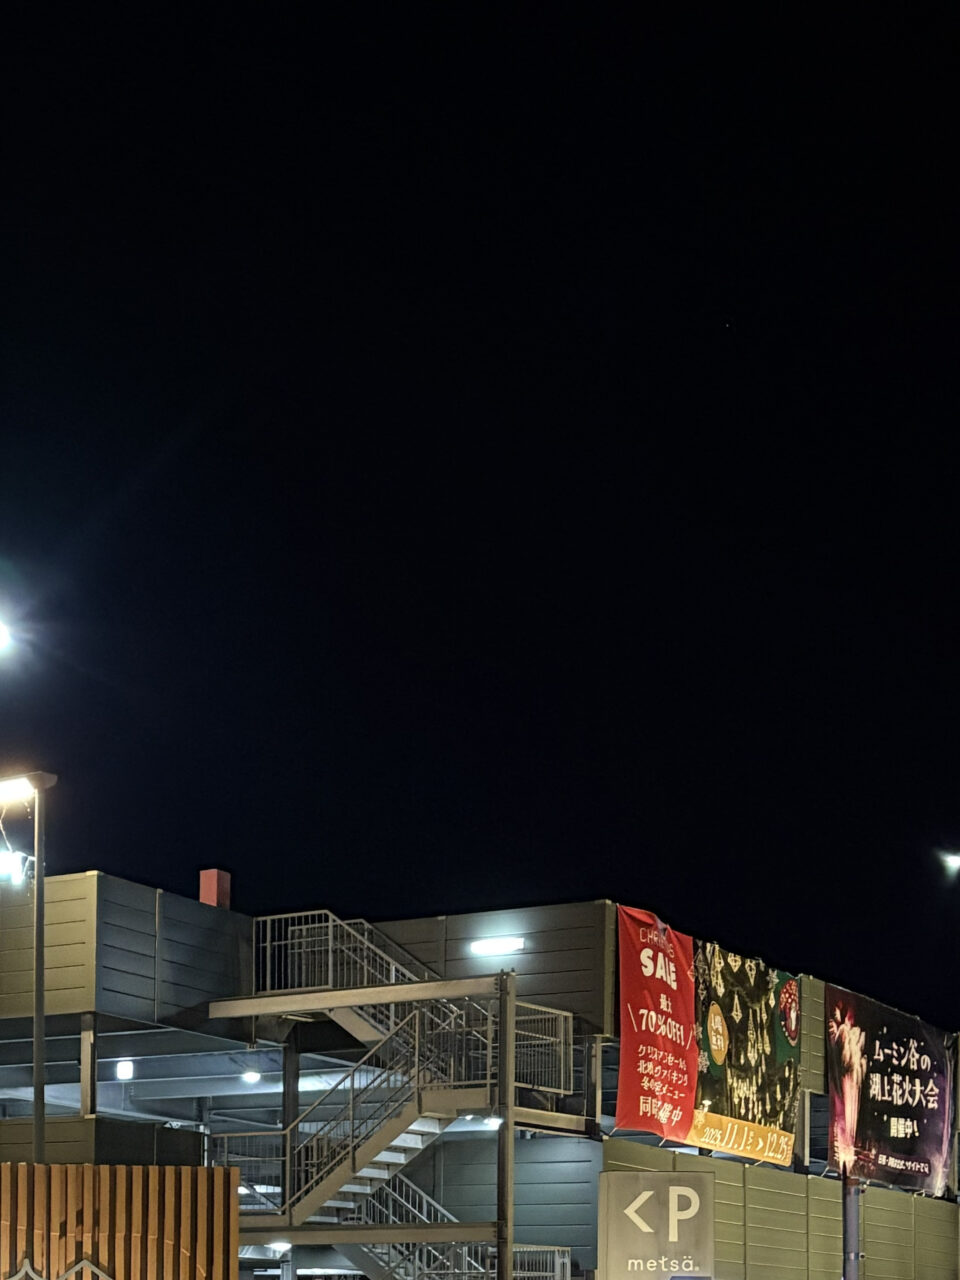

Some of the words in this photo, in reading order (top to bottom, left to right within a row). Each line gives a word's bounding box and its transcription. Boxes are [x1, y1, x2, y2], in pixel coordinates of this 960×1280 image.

[640, 948, 677, 990] SALE
[874, 1038, 931, 1072] ムーミン谷の
[869, 1072, 939, 1110] 湖上花火大会
[668, 1186, 700, 1242] P
[627, 1255, 694, 1272] metsä
